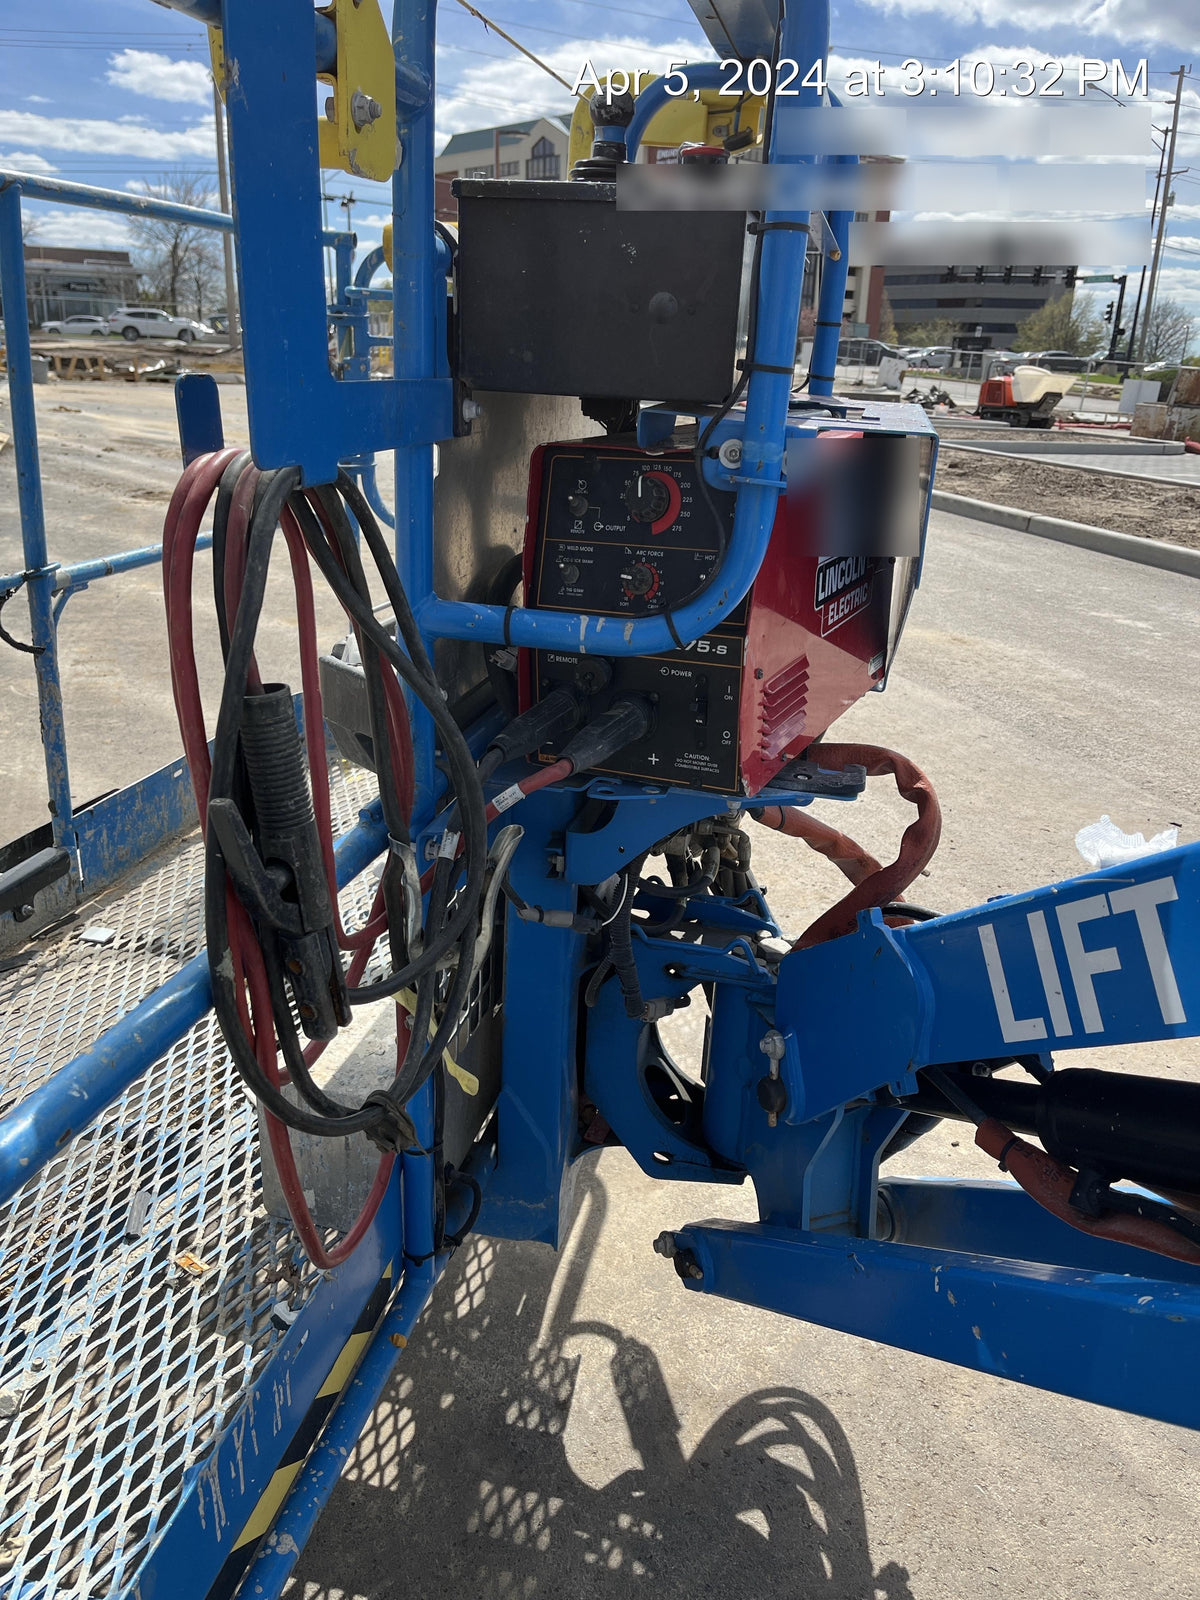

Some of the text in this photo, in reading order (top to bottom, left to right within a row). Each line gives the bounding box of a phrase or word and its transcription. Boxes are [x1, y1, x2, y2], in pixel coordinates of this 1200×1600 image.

[818, 556, 866, 601] LINCOLN
[828, 583, 868, 626] ELECTRIC
[556, 656, 578, 664] REMOTE
[671, 670, 692, 678] POWER
[977, 875, 1187, 1044] LIFT
